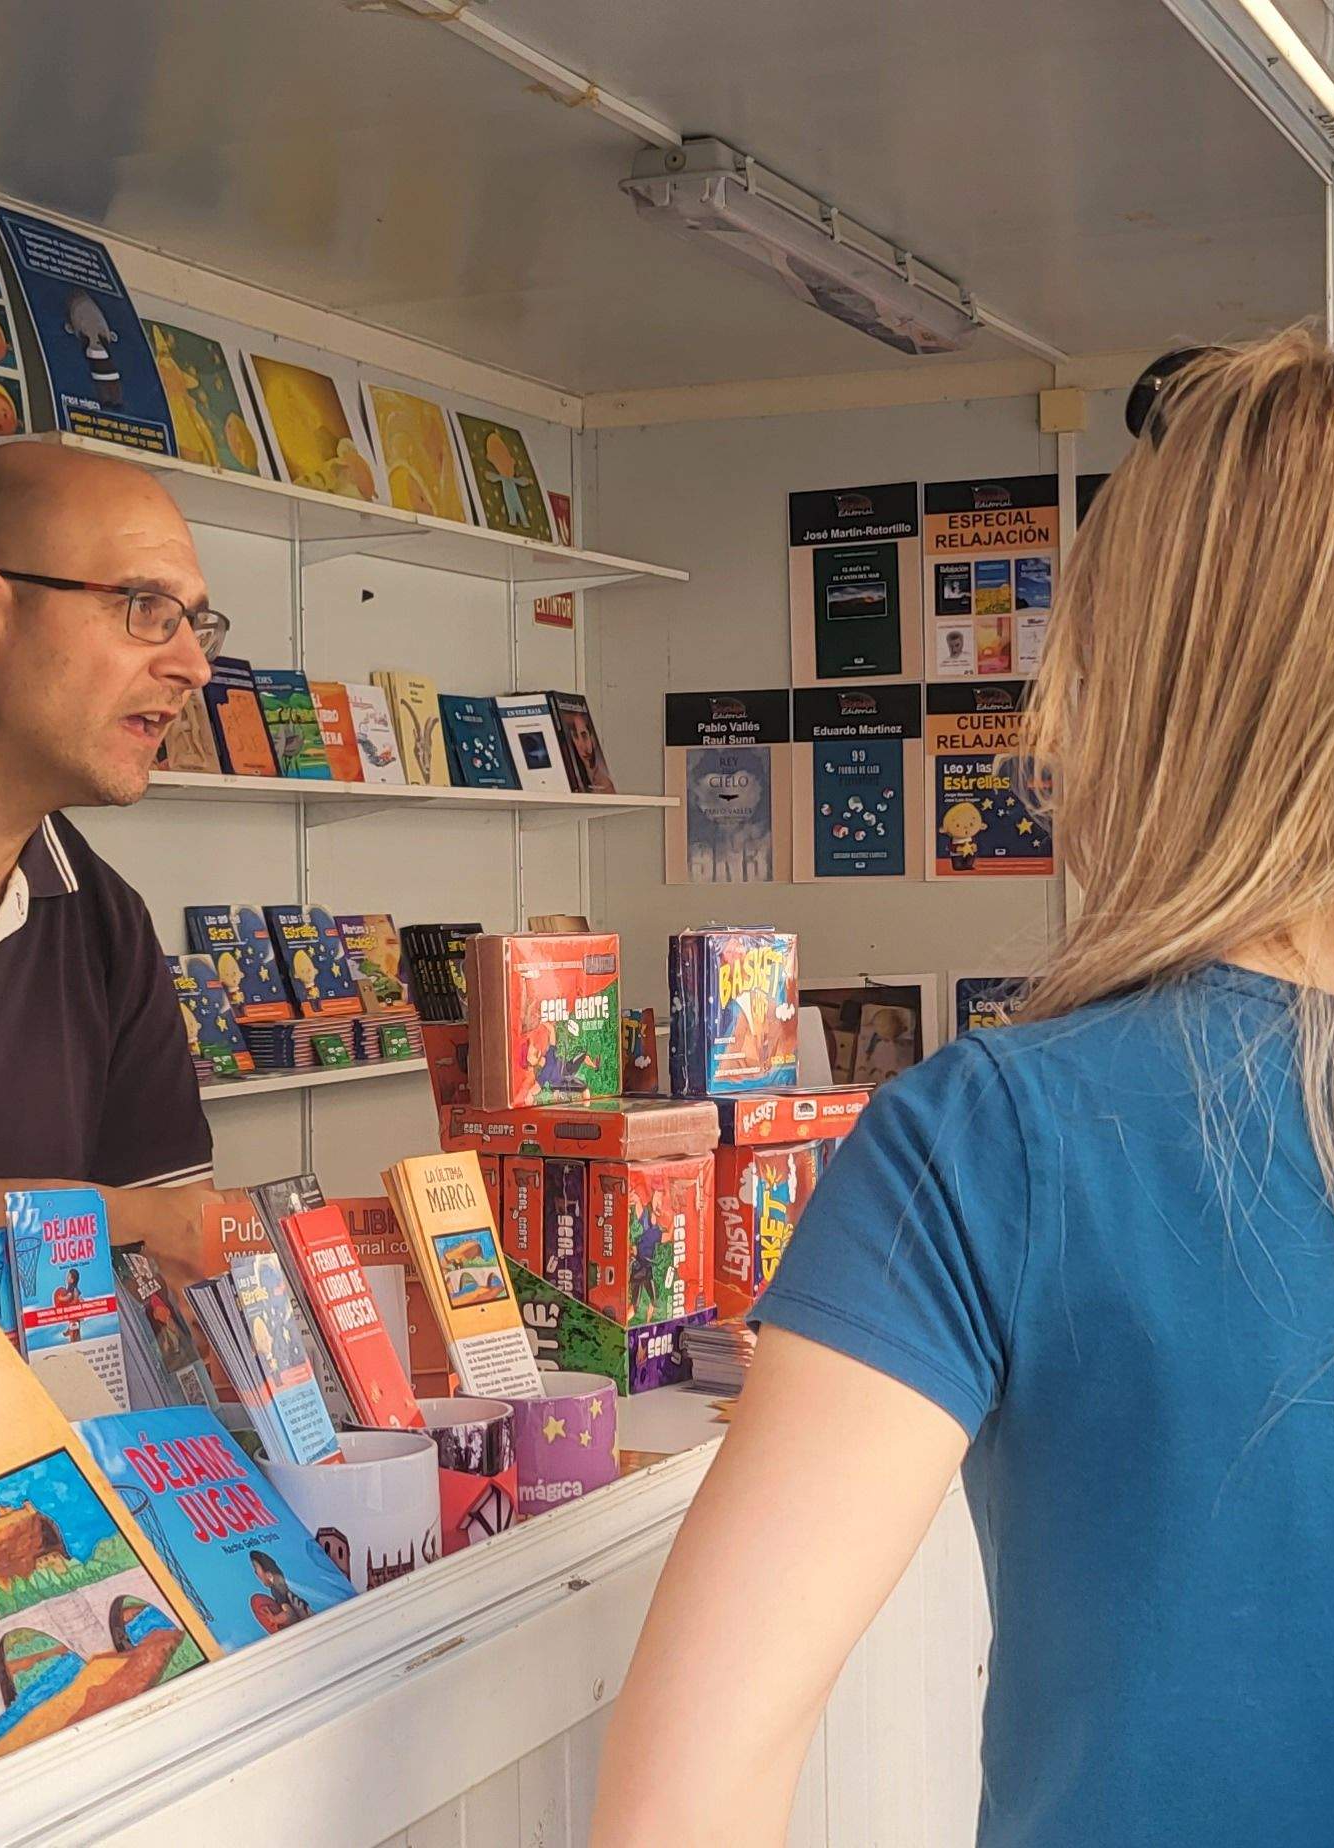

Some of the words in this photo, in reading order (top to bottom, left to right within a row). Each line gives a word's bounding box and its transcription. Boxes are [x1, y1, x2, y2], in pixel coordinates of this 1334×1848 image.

[948, 510, 1037, 530] ESPECIAL
[803, 529, 828, 541] José
[935, 525, 1050, 549] RELAJACIÓN
[697, 723, 727, 733] Pablo
[730, 721, 760, 732] Vallés
[813, 726, 857, 736] Eduardo
[859, 724, 903, 735] Martínez
[957, 714, 1026, 730] CUENT
[728, 734, 755, 745] Sunn
[937, 732, 1020, 749] RELAJAC
[851, 750, 866, 762] 99
[943, 763, 964, 774] Leo
[965, 764, 973, 775] y
[976, 762, 992, 773] las
[709, 775, 749, 788] CIELO
[943, 774, 1011, 791] Estrellas
[719, 947, 785, 1010] BASKET
[742, 1101, 779, 1134] BASKET
[424, 1170, 435, 1184] LA
[435, 1165, 464, 1182] ÚLTIMA
[426, 1183, 477, 1213] MARCA
[42, 1213, 98, 1242] DÉJAME
[717, 1196, 748, 1281] BASKET
[760, 1199, 787, 1282] SKET
[50, 1238, 97, 1267] JUGAR
[321, 1273, 349, 1302] LIBRO
[332, 1297, 378, 1332] HUESCA
[123, 1431, 248, 1495] DÉJAME
[519, 1479, 583, 1502] mágica
[176, 1483, 279, 1544] JUGAR
